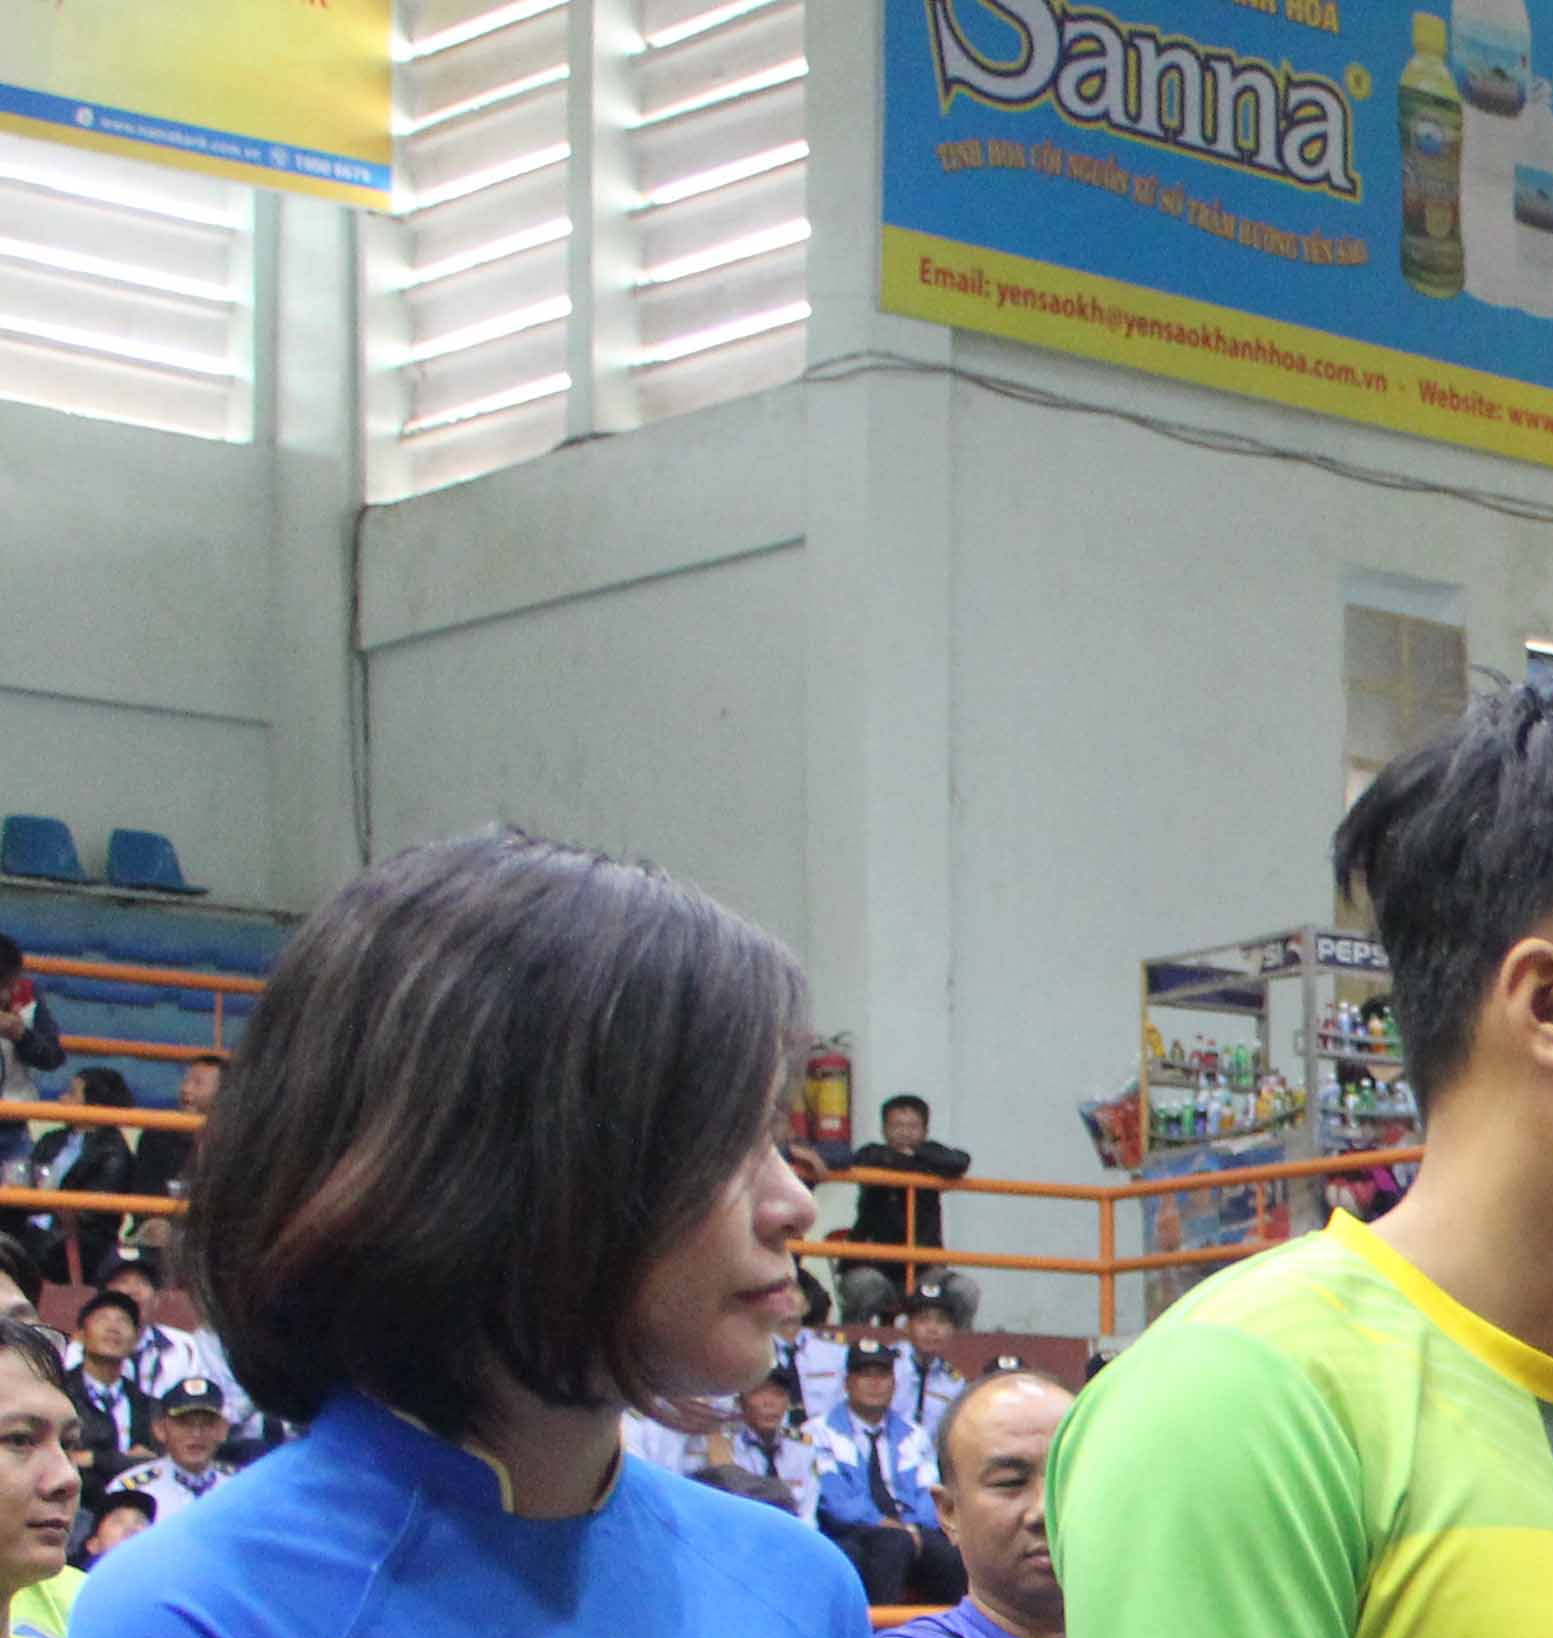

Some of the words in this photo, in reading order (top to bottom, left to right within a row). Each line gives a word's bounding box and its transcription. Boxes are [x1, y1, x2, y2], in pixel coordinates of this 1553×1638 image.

[932, 0, 1360, 199] Sanna
[919, 256, 990, 298] Email:
[1418, 378, 1503, 421] Website:
[1317, 936, 1390, 968] PEPS
